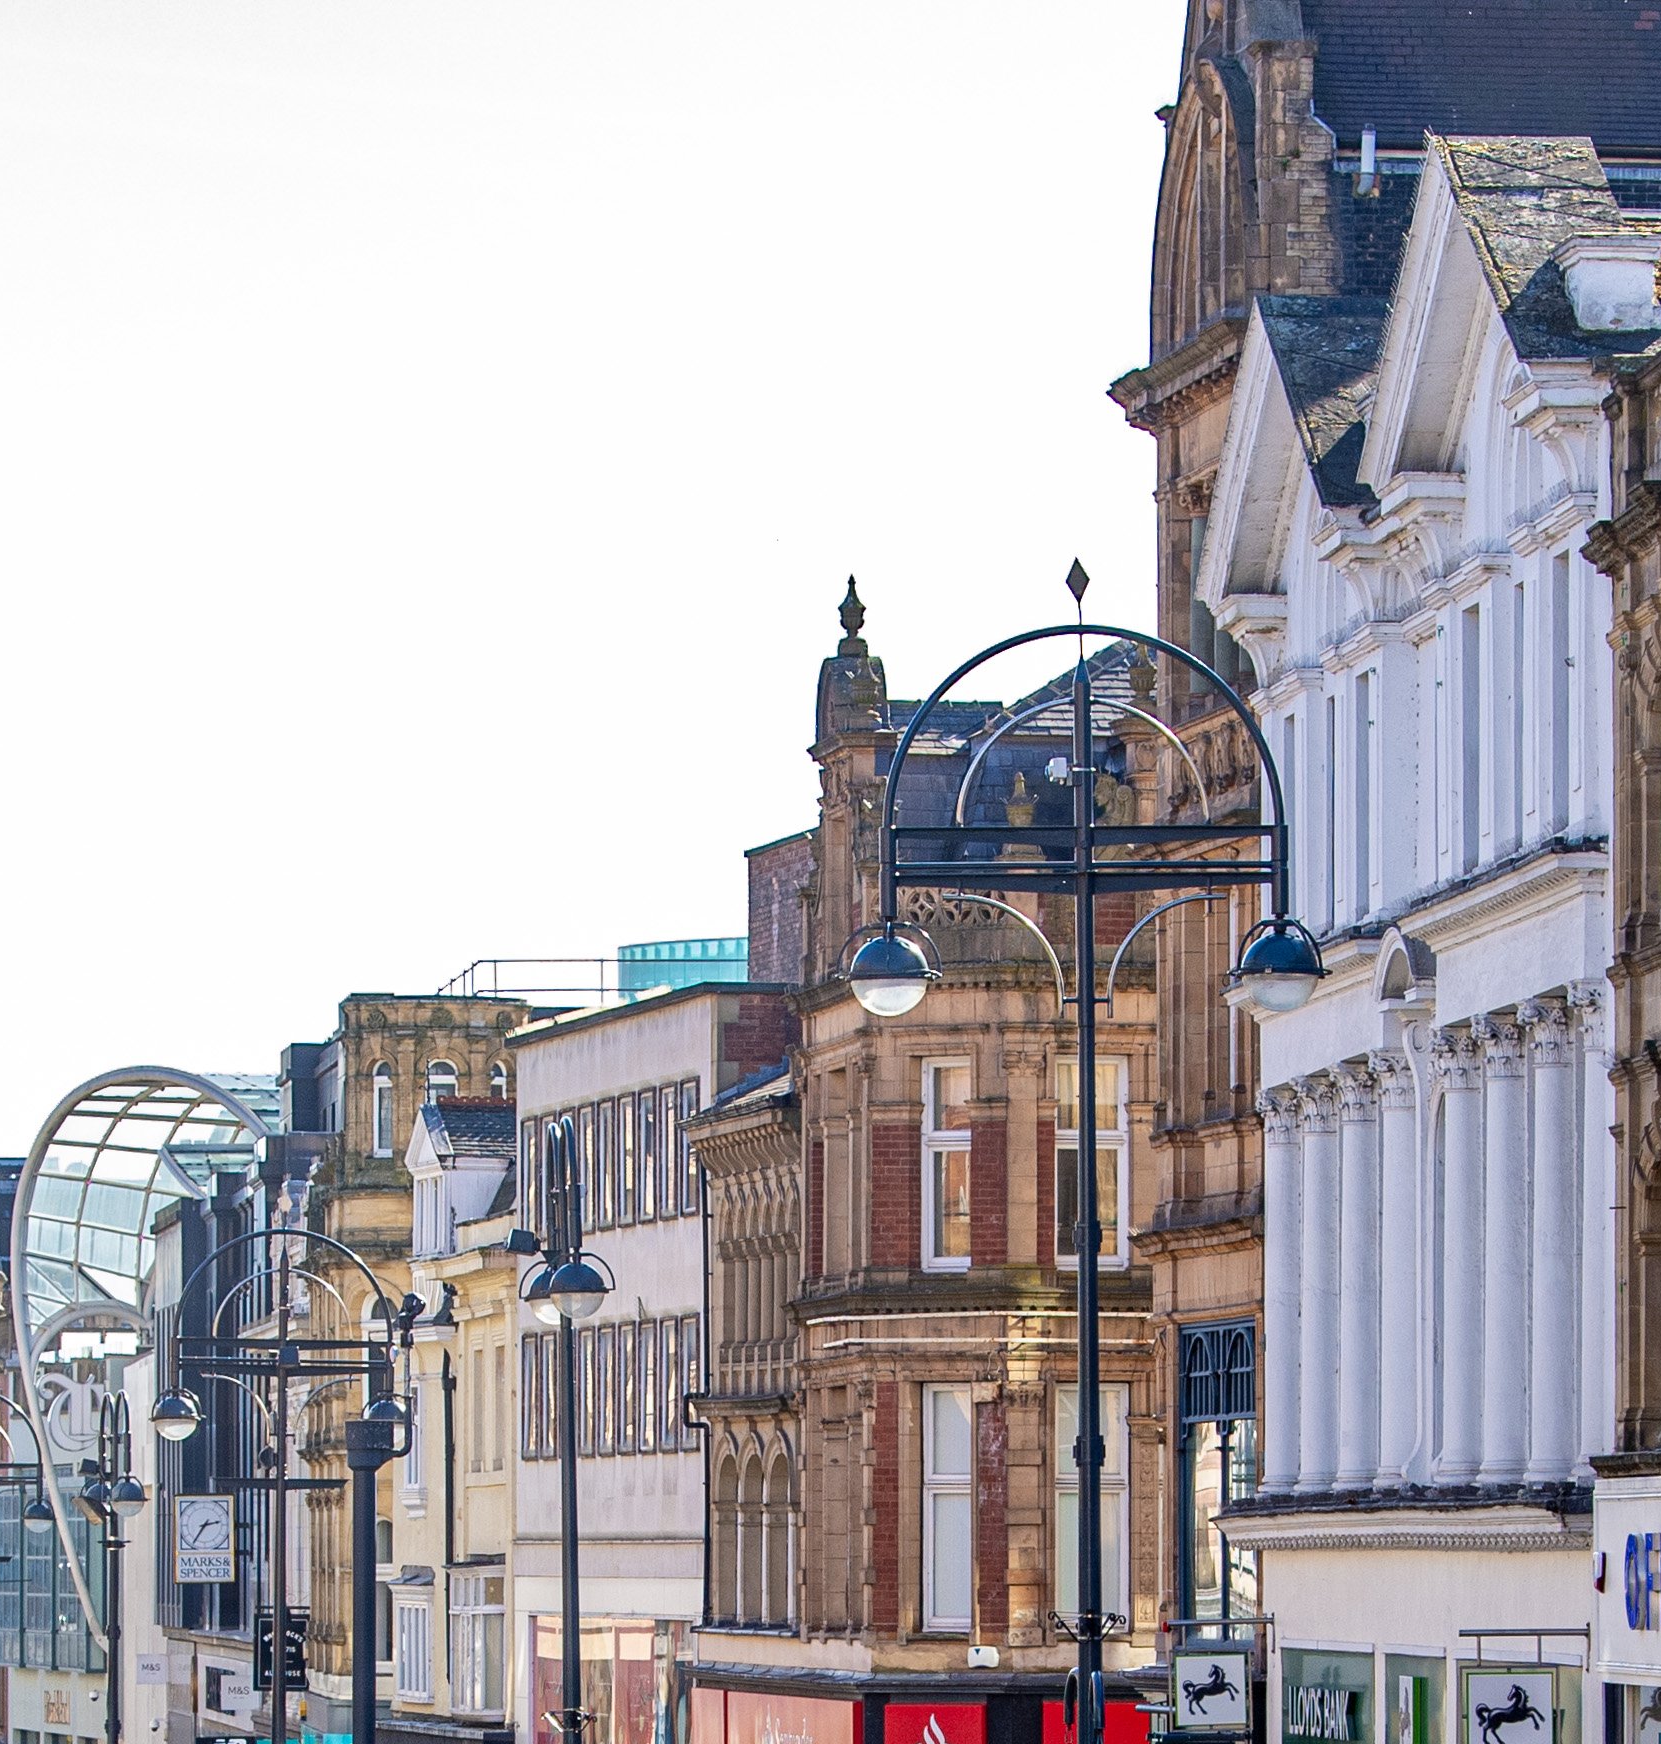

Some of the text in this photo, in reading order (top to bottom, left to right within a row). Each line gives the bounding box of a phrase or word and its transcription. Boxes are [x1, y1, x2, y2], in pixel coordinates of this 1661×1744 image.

[180, 1557, 222, 1568] MARKS
[180, 1568, 231, 1578] SPENCER
[141, 1663, 161, 1672] M&S
[228, 1686, 250, 1696] M&S
[1289, 1685, 1351, 1741] LLOYDS BANK
